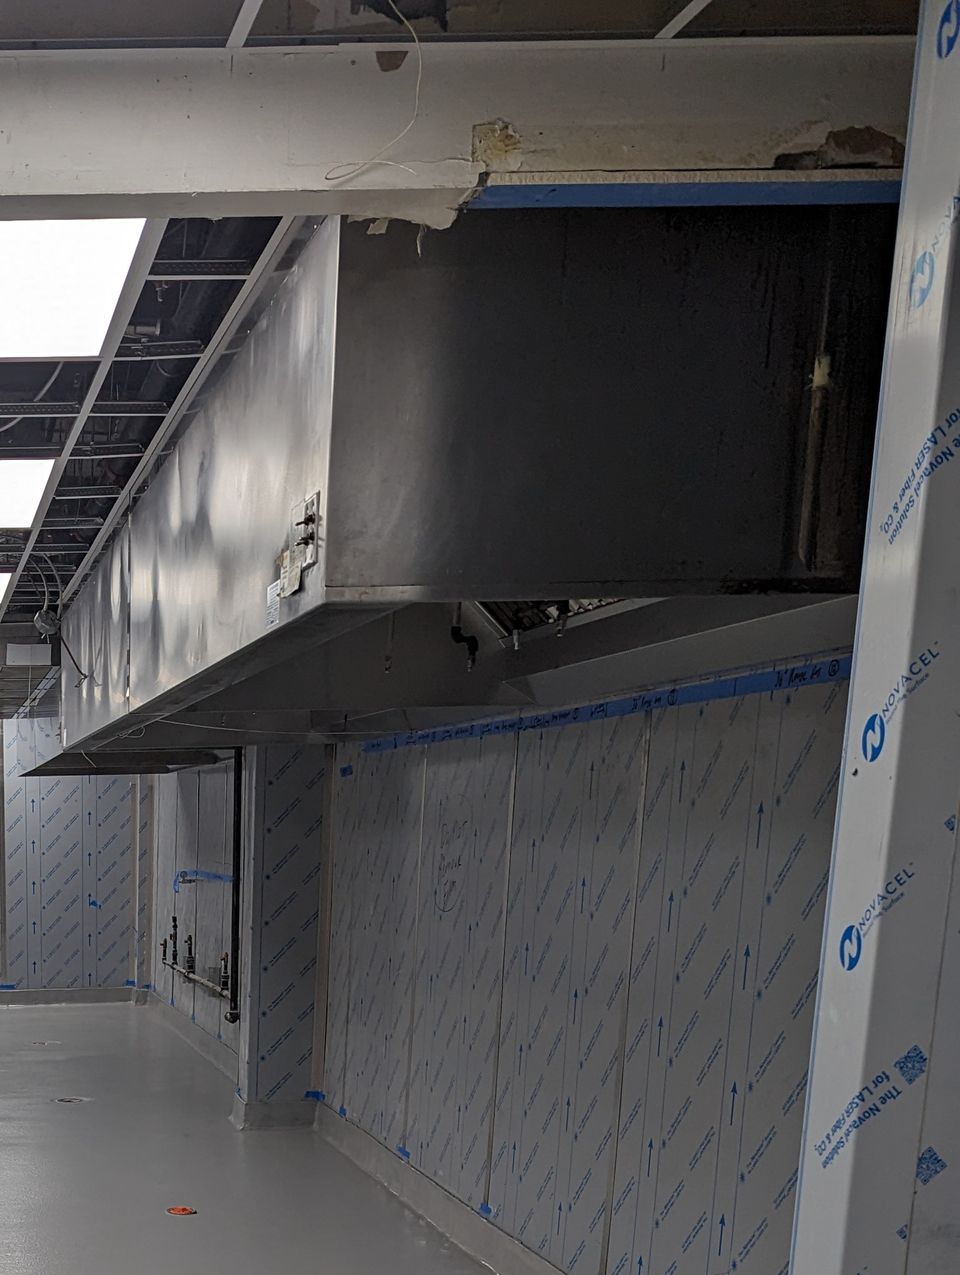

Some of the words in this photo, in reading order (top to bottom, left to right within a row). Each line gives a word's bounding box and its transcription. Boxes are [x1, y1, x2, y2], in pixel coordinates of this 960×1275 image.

[914, 426, 947, 471] LASER
[914, 445, 954, 497] Novacel
[898, 467, 916, 501] Fiber
[888, 495, 915, 544] Solution
[881, 648, 940, 718] NOVACEL
[858, 868, 915, 931] NOVACEL
[872, 1071, 891, 1089] for
[878, 1085, 903, 1105] The
